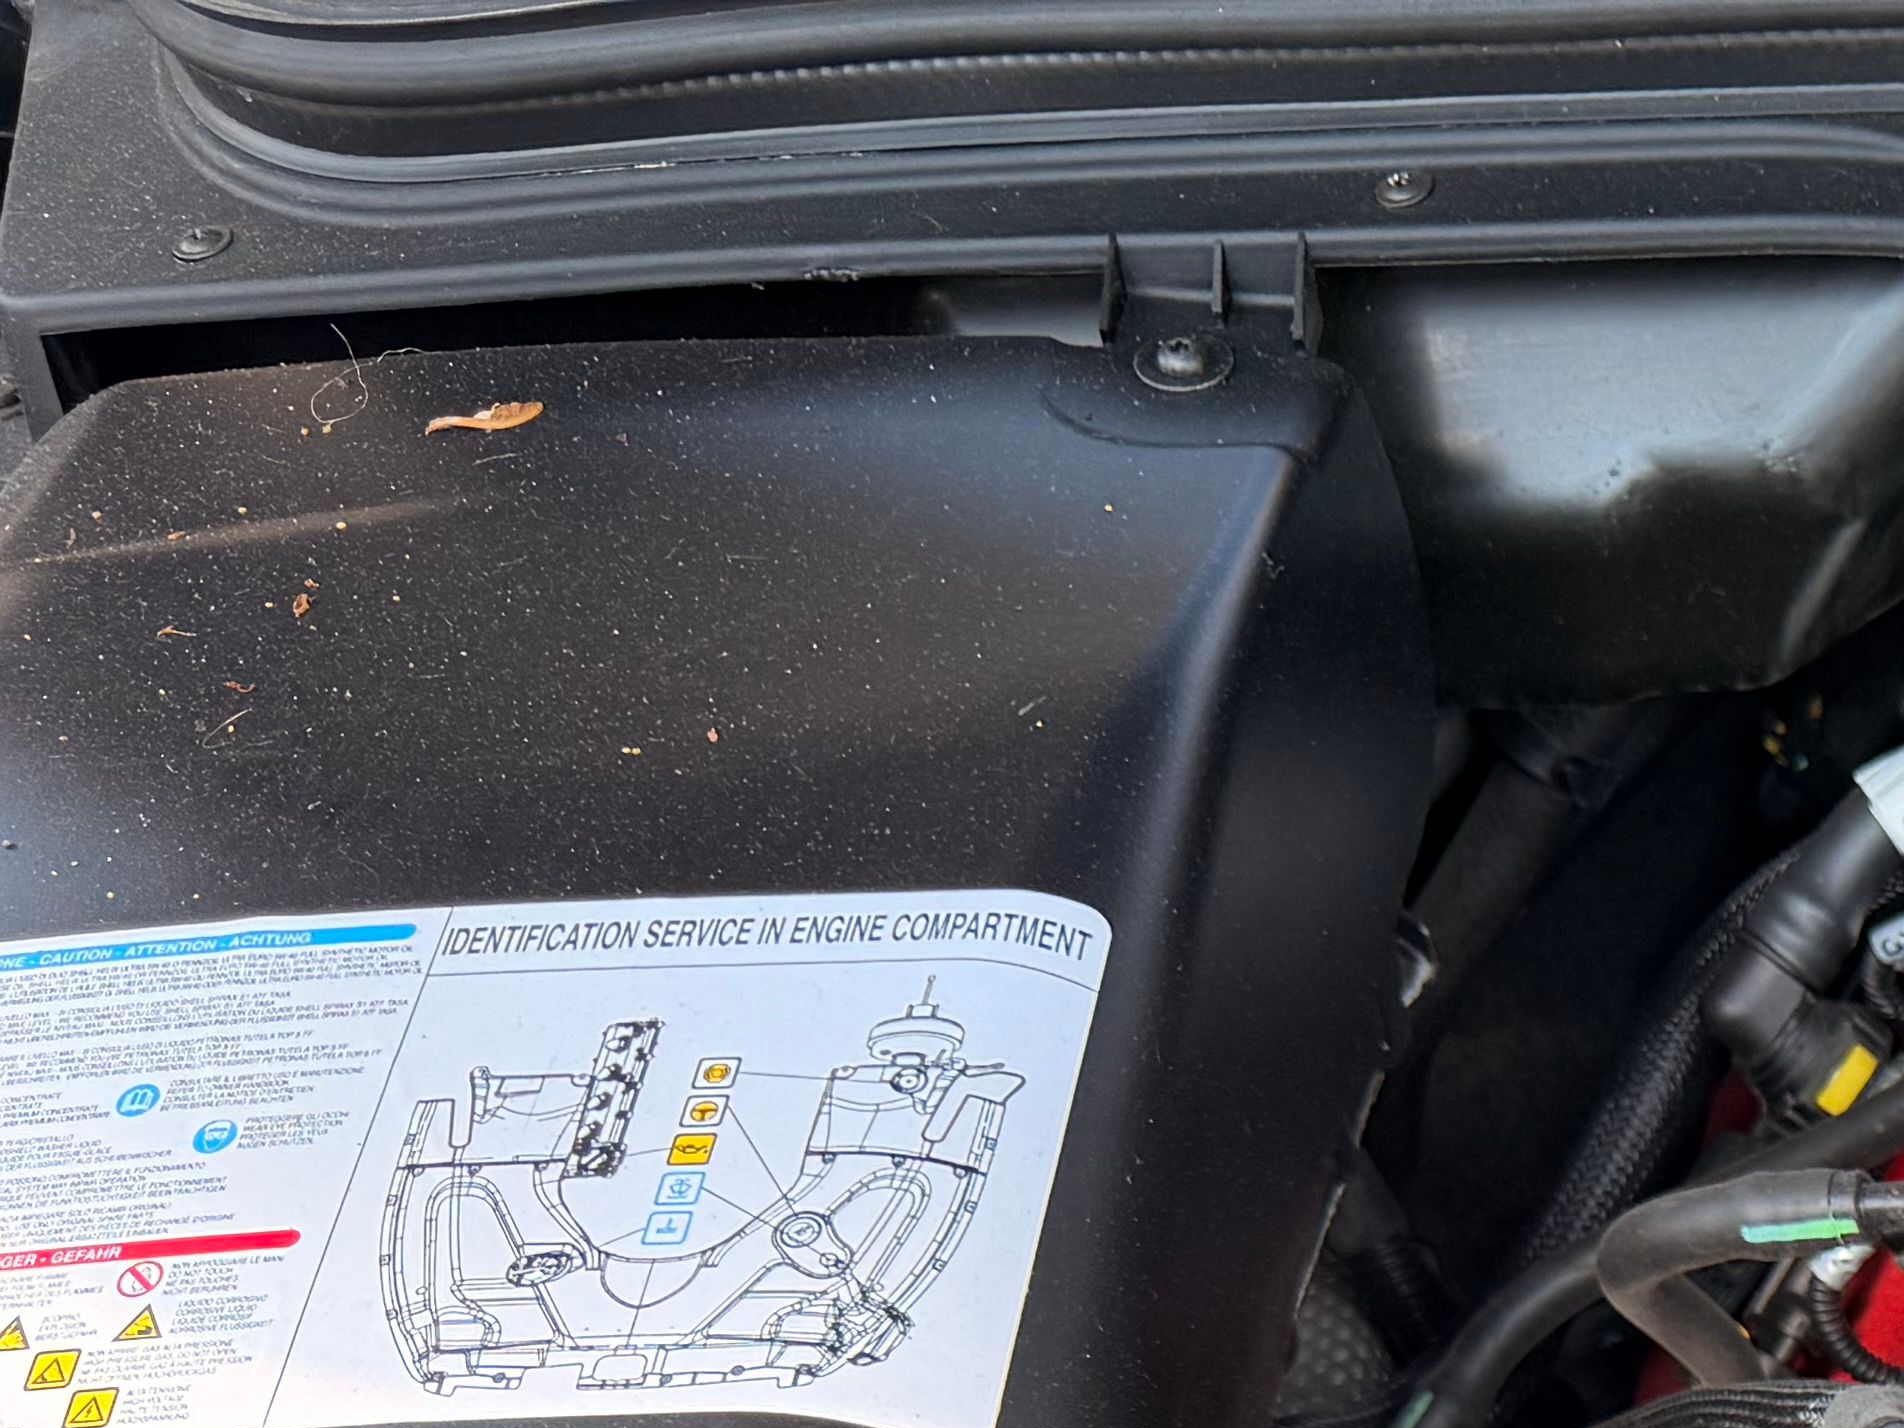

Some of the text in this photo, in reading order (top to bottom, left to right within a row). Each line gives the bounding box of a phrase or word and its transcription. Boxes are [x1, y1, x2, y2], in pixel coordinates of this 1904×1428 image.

[39, 948, 113, 965] CAUTION
[124, 940, 218, 957] ATTENTION
[229, 932, 313, 948] ACHTUNG
[442, 912, 1093, 962] IDENTIFICATION SERVICE IN ENGINE COMPARTMENT
[51, 1246, 122, 1263] GEFAHR
